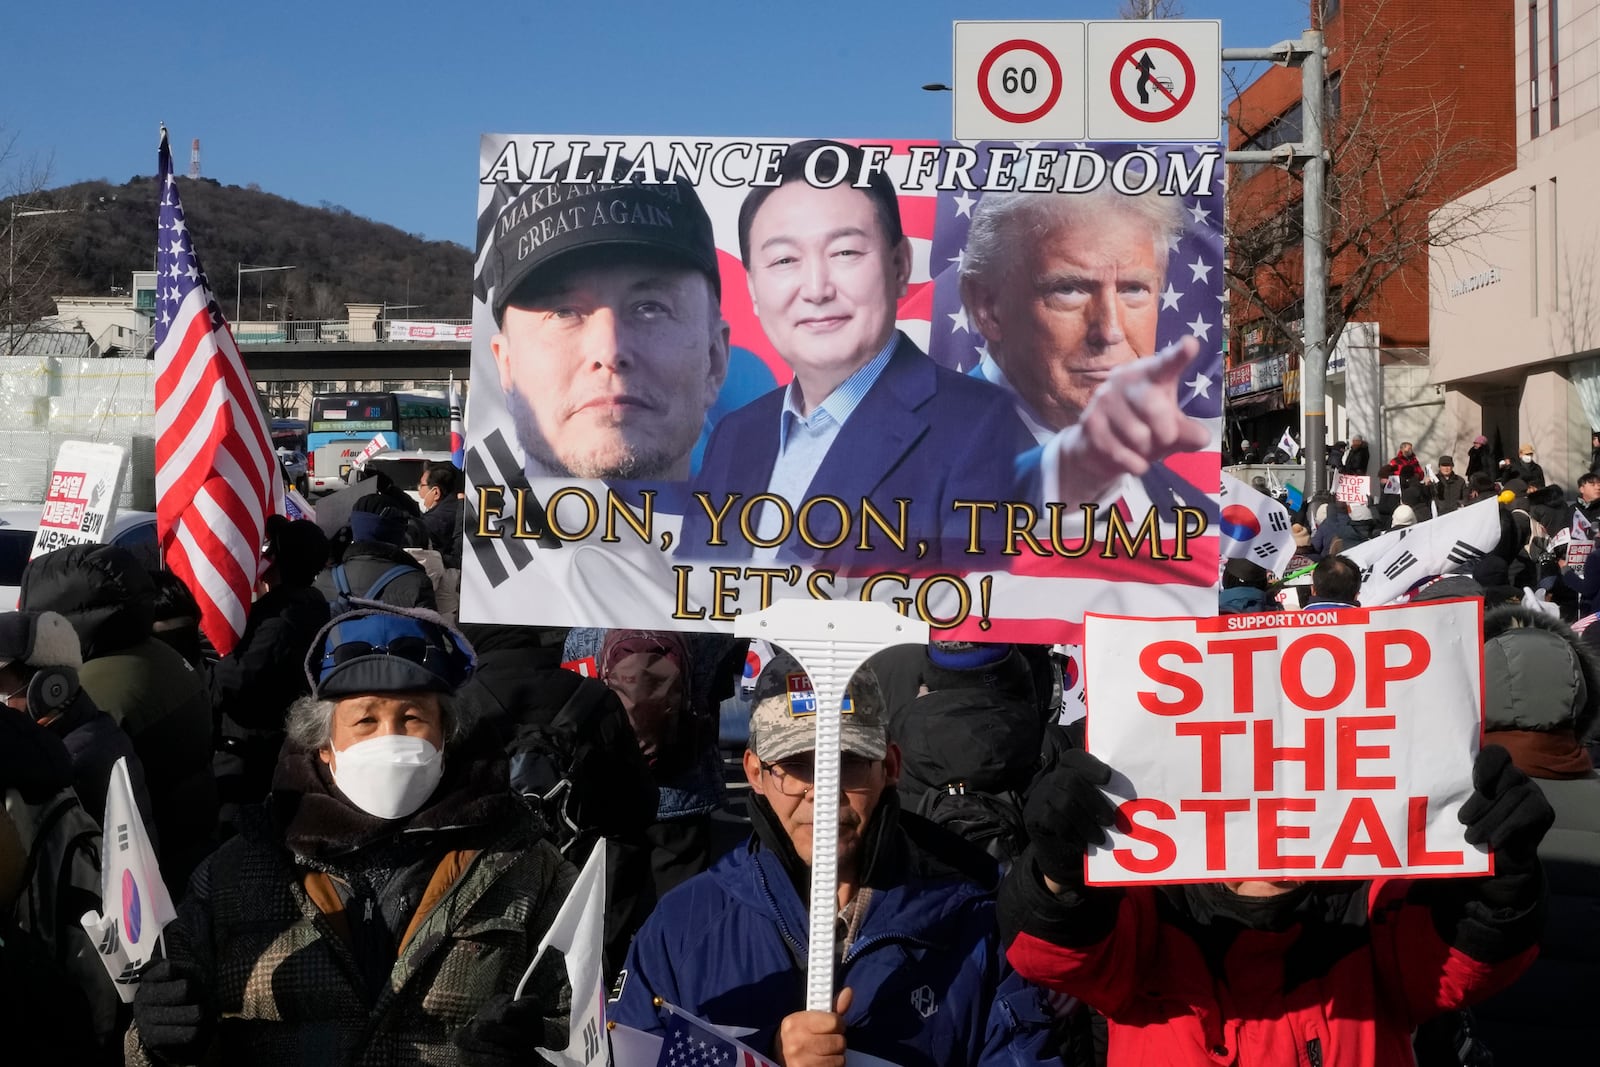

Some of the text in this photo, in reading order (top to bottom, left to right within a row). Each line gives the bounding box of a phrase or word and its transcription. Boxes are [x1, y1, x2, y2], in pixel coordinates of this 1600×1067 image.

[1002, 67, 1037, 94] 60
[480, 141, 1221, 196] ALLIANCE OF FREEDOM
[500, 183, 562, 238] MAKE
[517, 200, 673, 261] GREAT AGAIN
[49, 475, 83, 499] 윤석열
[1335, 492, 1367, 504] STEAL
[1338, 475, 1364, 486] STOP
[1340, 484, 1361, 494] THE
[42, 500, 85, 526] 대통령과
[475, 486, 1208, 561] ELON, YOON, TRUMP
[860, 572, 994, 631] GO!
[1228, 611, 1338, 630] SUPPORT YOON
[1137, 629, 1431, 716] STOP
[1175, 715, 1396, 793] THE
[1112, 796, 1464, 874] STEAL
